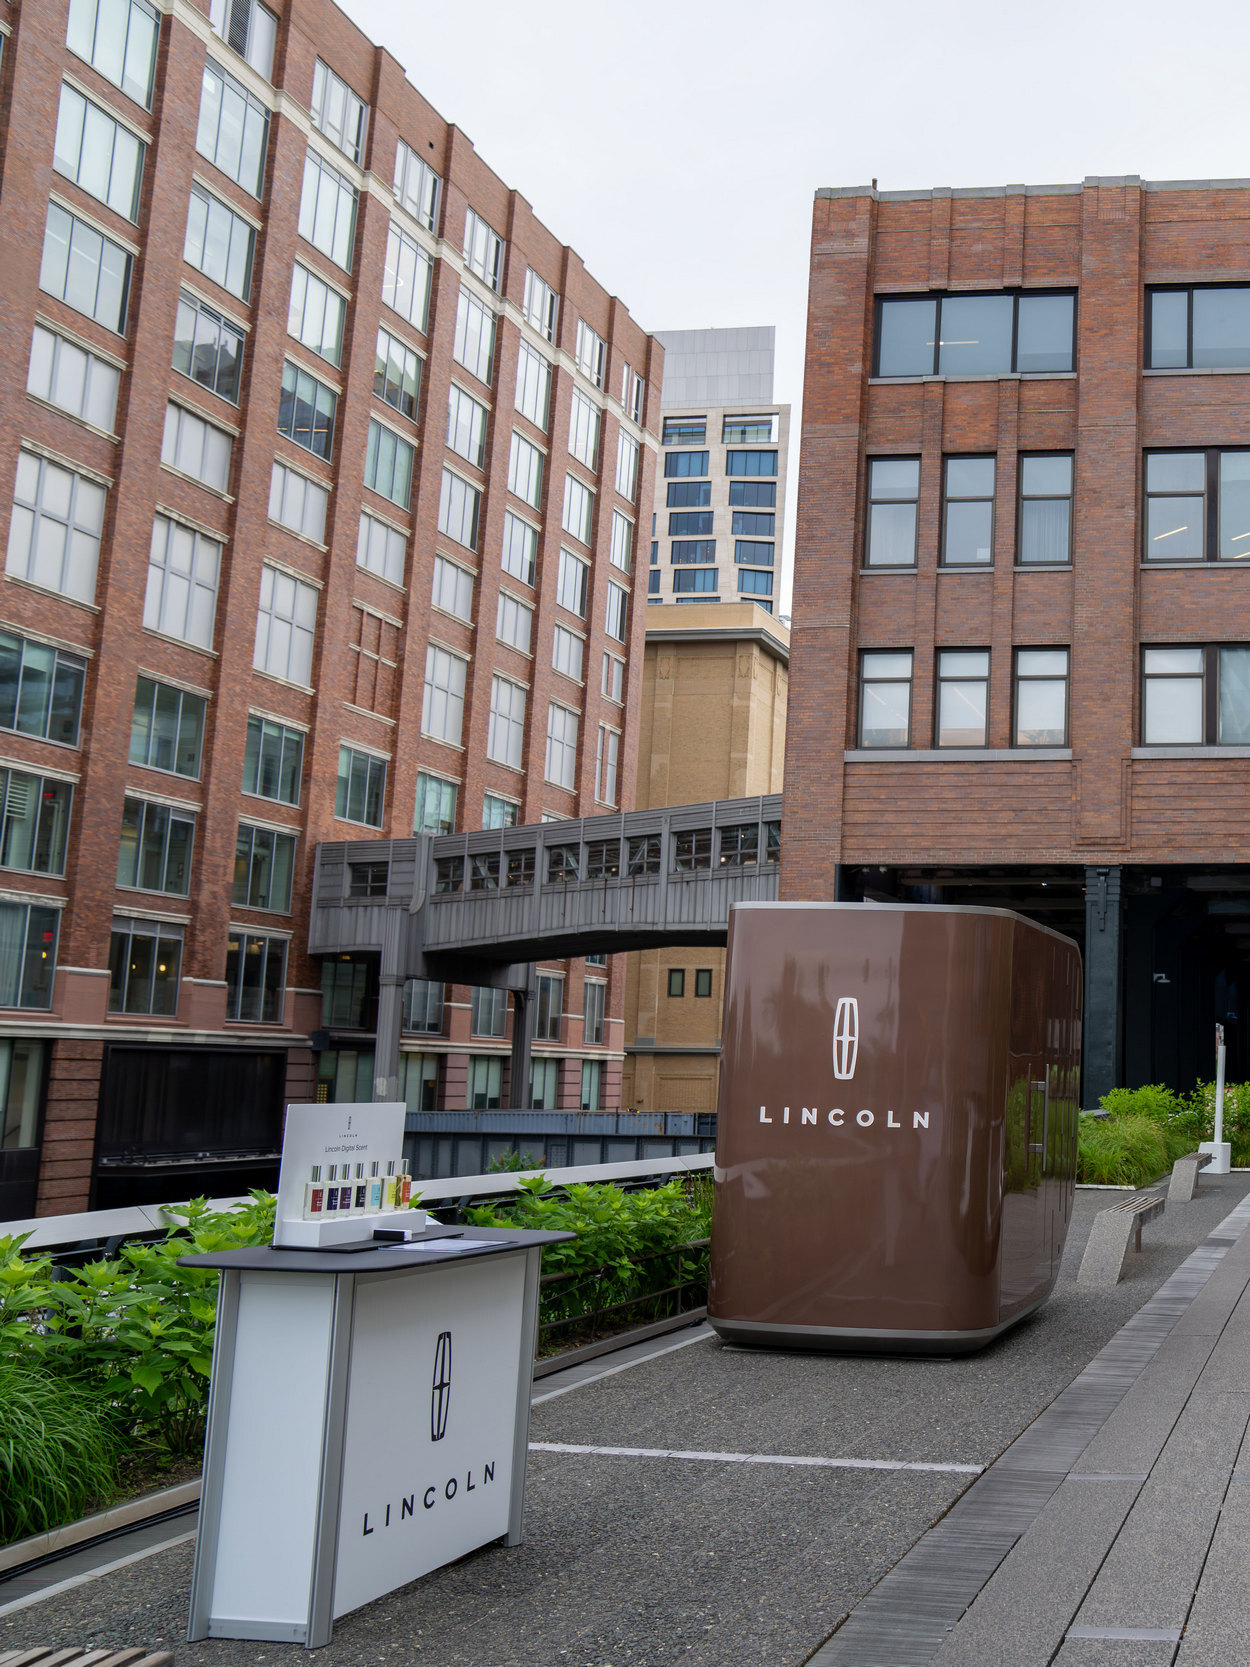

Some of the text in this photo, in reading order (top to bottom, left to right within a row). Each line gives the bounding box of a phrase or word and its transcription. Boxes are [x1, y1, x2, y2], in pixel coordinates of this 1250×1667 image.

[759, 1106, 930, 1129] LINCOLN
[324, 1145, 341, 1153] Lincoln
[341, 1144, 355, 1153] Digital
[363, 1461, 495, 1536] LINCOLN
